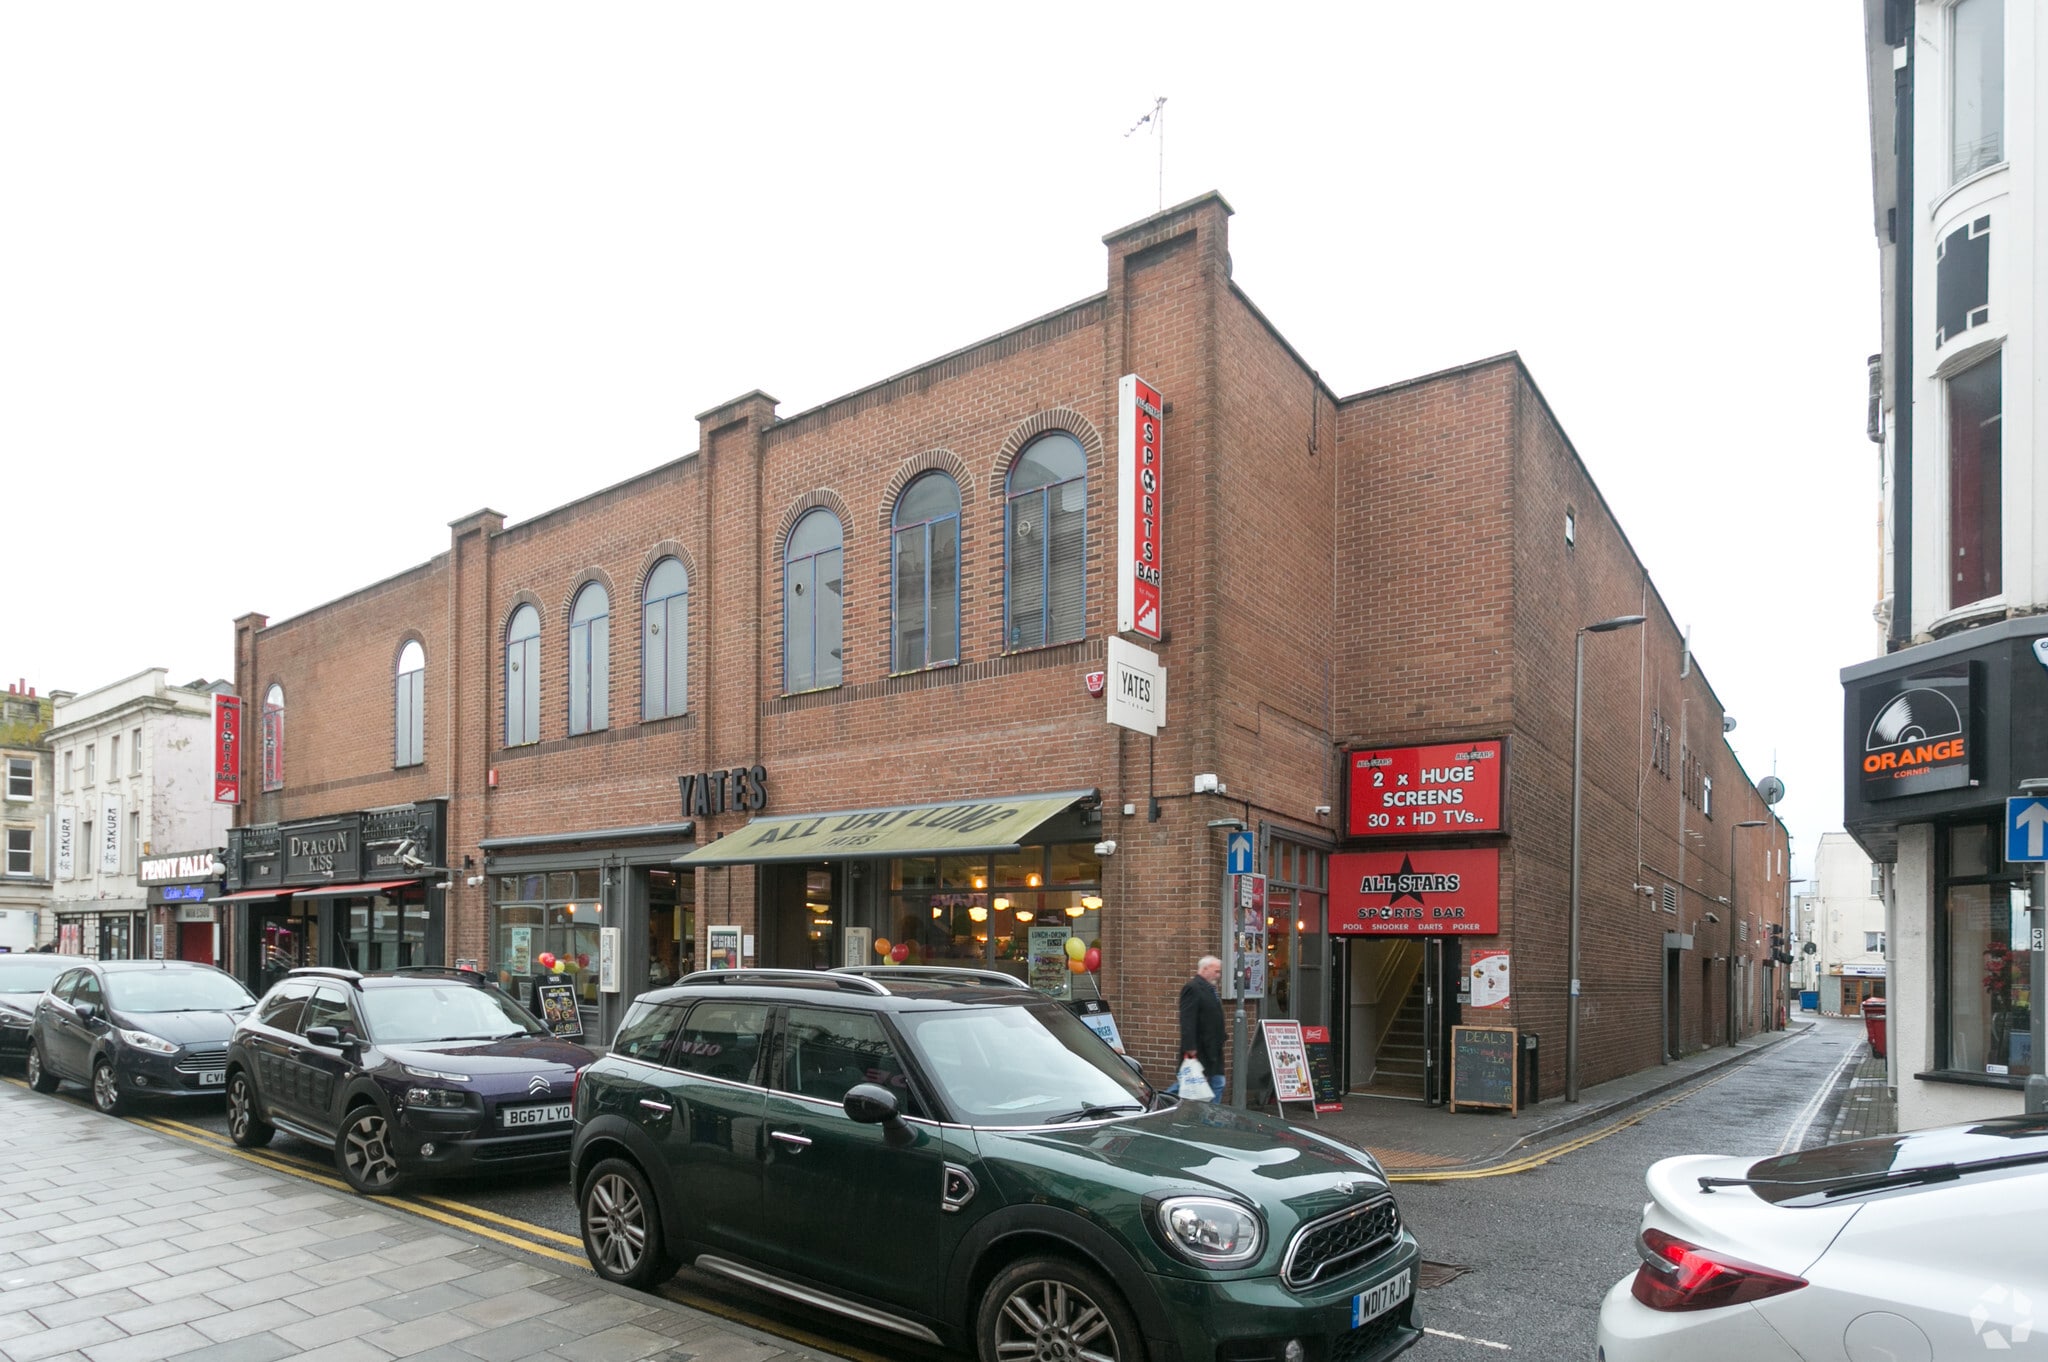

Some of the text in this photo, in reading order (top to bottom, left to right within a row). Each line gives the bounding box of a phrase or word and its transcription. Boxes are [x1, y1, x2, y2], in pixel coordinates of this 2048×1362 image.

[1136, 560, 1160, 587] BAR
[1122, 671, 1150, 702] YATES
[1864, 738, 1965, 773] ORANGE
[1373, 766, 1475, 787] 2 x HUGE
[1893, 767, 1930, 779] CORNER
[679, 765, 767, 816] YATES
[1382, 788, 1464, 807] SCREENS
[107, 808, 117, 850] SAKURA
[749, 804, 1018, 847] ALL DAY LONG
[1368, 813, 1390, 827] 30
[1396, 815, 1406, 826] x
[1412, 811, 1437, 825] HD
[61, 818, 71, 857] SAKURA
[291, 831, 349, 857] DRAGON
[821, 833, 878, 847] YATES
[141, 853, 213, 880] PENNY FALLS
[308, 855, 334, 872] KISS
[376, 854, 404, 866] Restaura
[1360, 874, 1460, 893] ALL STARS
[1357, 906, 1466, 919] SPORTS BAR
[1465, 1031, 1507, 1044] DEALS
[510, 1106, 570, 1124] BG67 LYO
[1363, 1273, 1408, 1318] WD17 RJY
